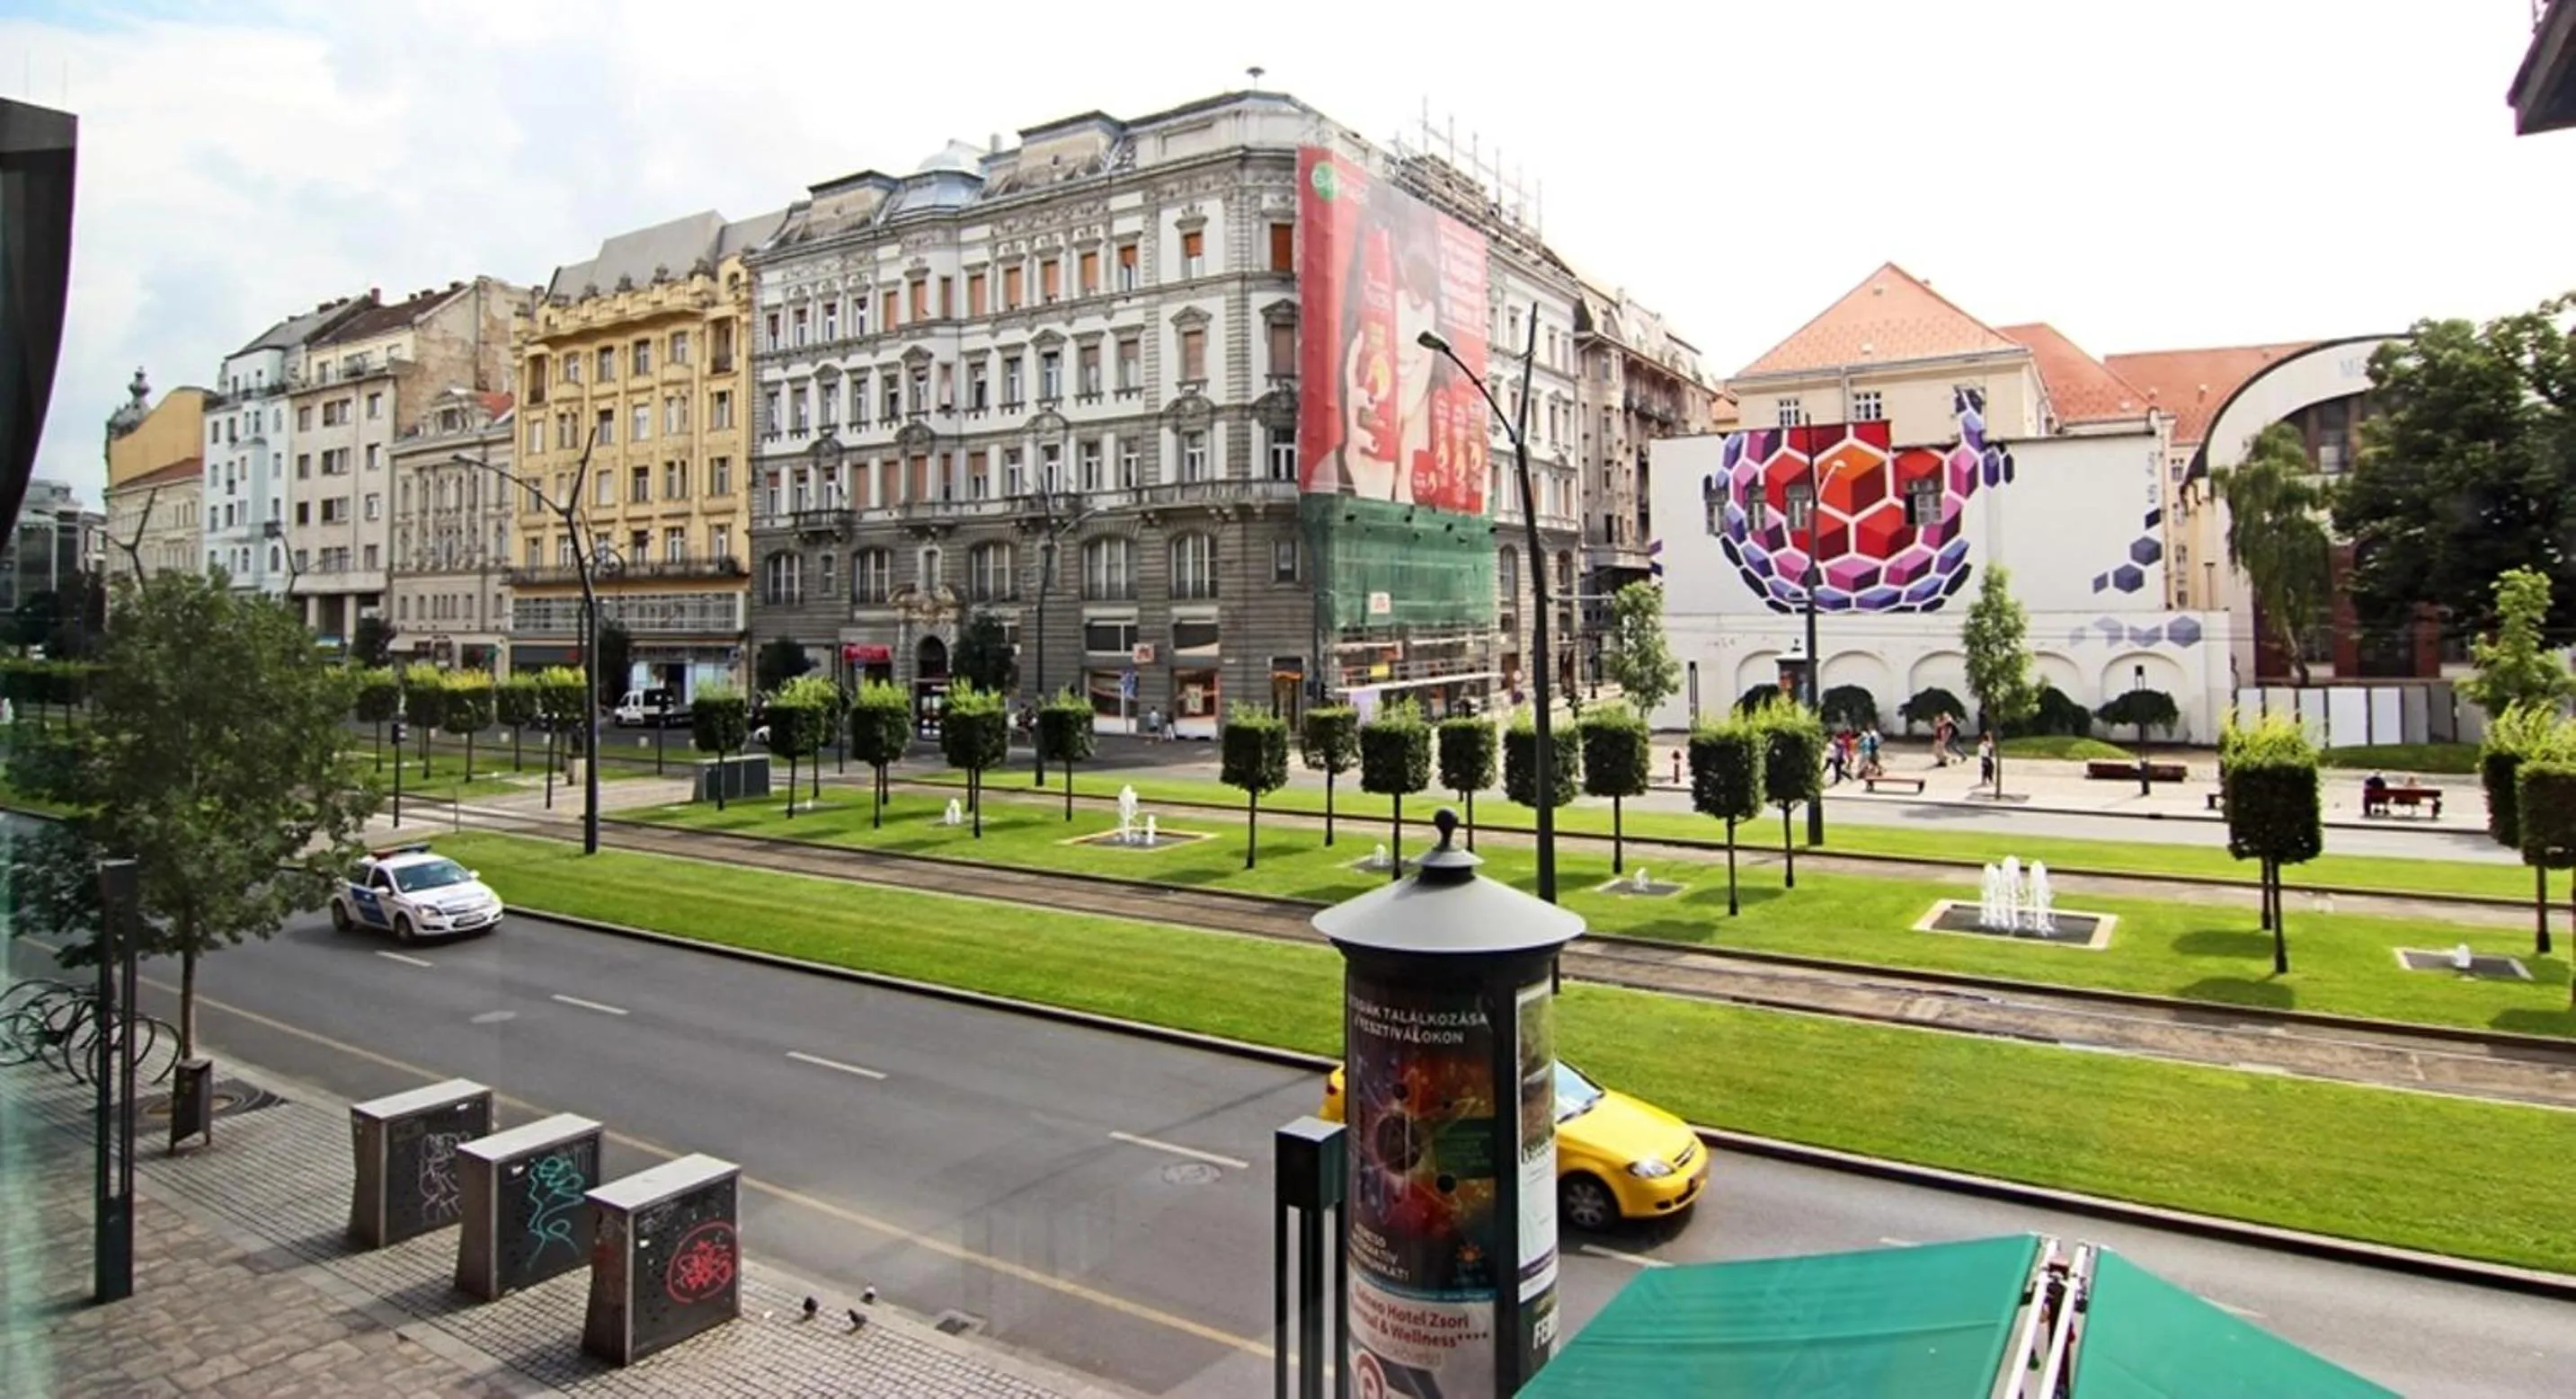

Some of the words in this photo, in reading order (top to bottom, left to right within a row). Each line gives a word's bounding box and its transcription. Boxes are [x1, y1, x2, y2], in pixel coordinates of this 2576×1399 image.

[1382, 1006, 1488, 1026] TALÁLKOZÁSA
[1387, 1303, 1426, 1325] Hotel
[1428, 1312, 1470, 1329] Zsori
[1380, 1319, 1389, 1335] &
